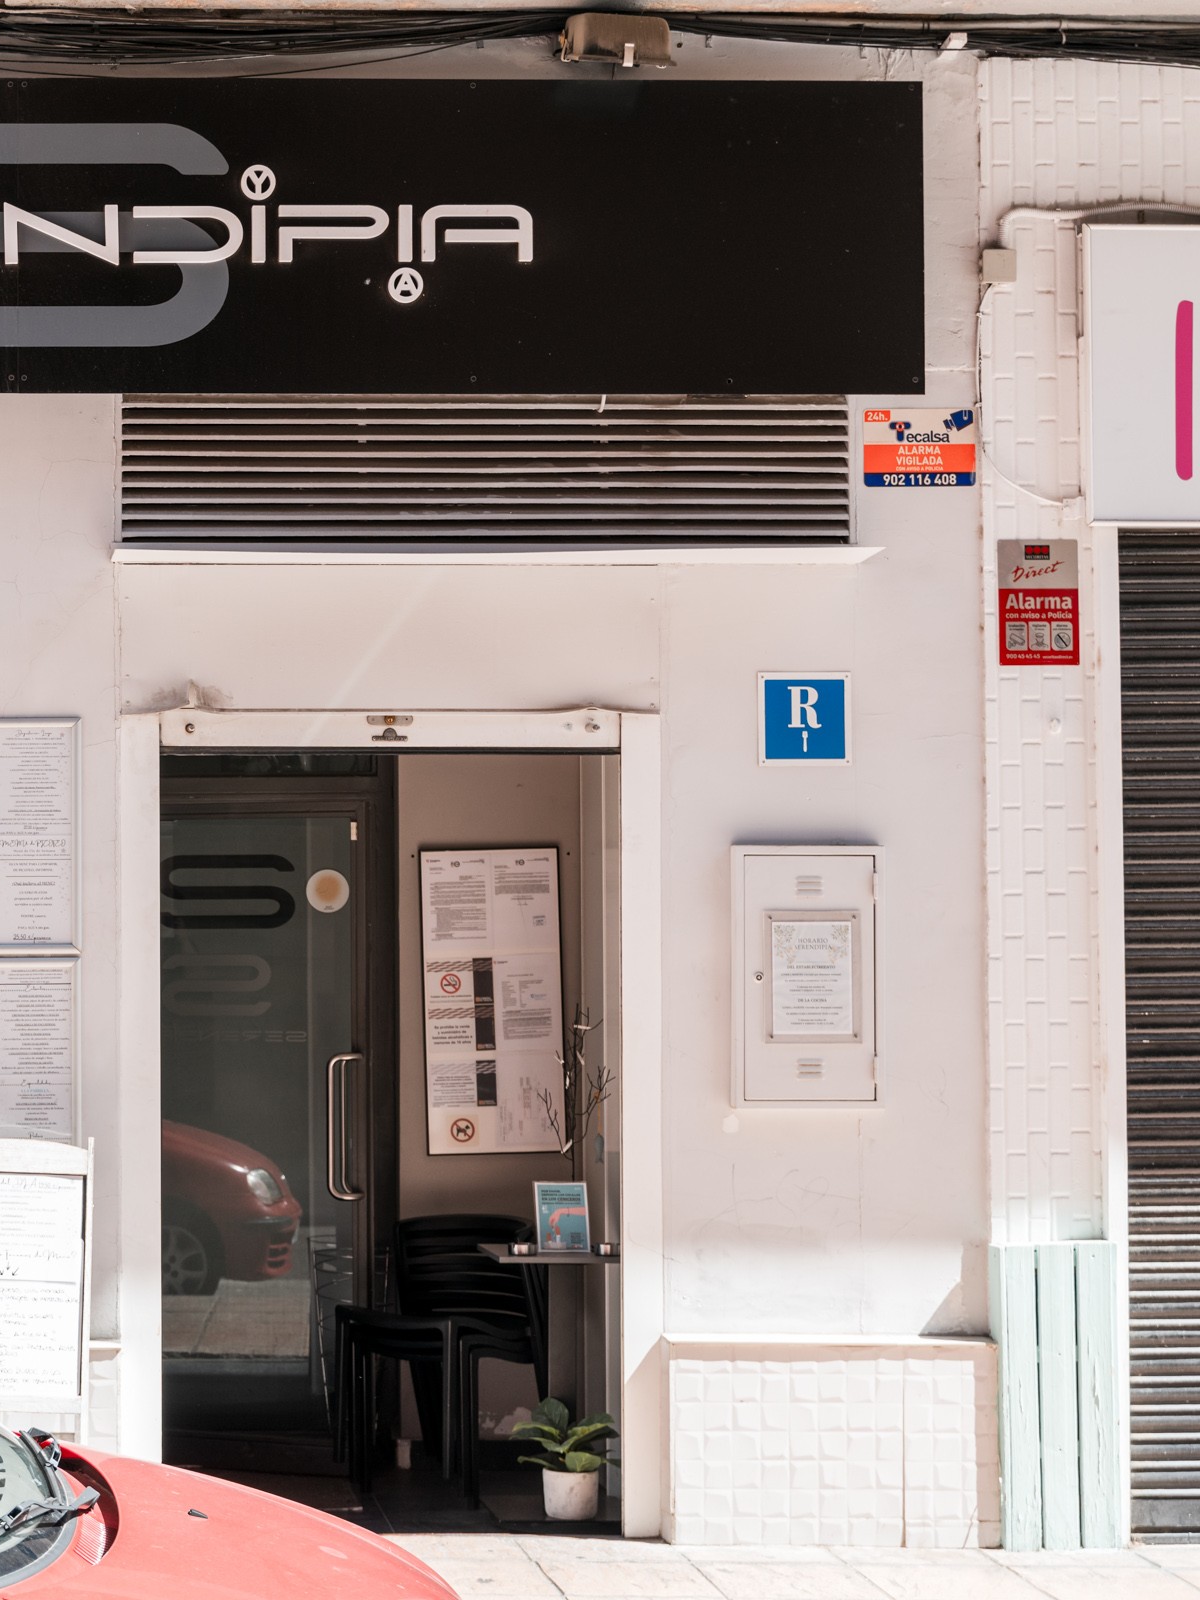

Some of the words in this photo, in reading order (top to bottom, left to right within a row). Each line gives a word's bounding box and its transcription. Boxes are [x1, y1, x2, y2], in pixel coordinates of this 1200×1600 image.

[867, 411, 889, 421] 24h.
[889, 421, 950, 443] Tecalsa
[897, 446, 941, 455] ALARMA
[896, 456, 943, 465] VIGILADA
[883, 474, 906, 486] 902
[909, 474, 931, 486] 116
[934, 474, 957, 486] 408
[1011, 560, 1065, 583] Direct
[1005, 592, 1073, 610] Alarma
[1020, 611, 1040, 619] aviso
[788, 686, 822, 729] R
